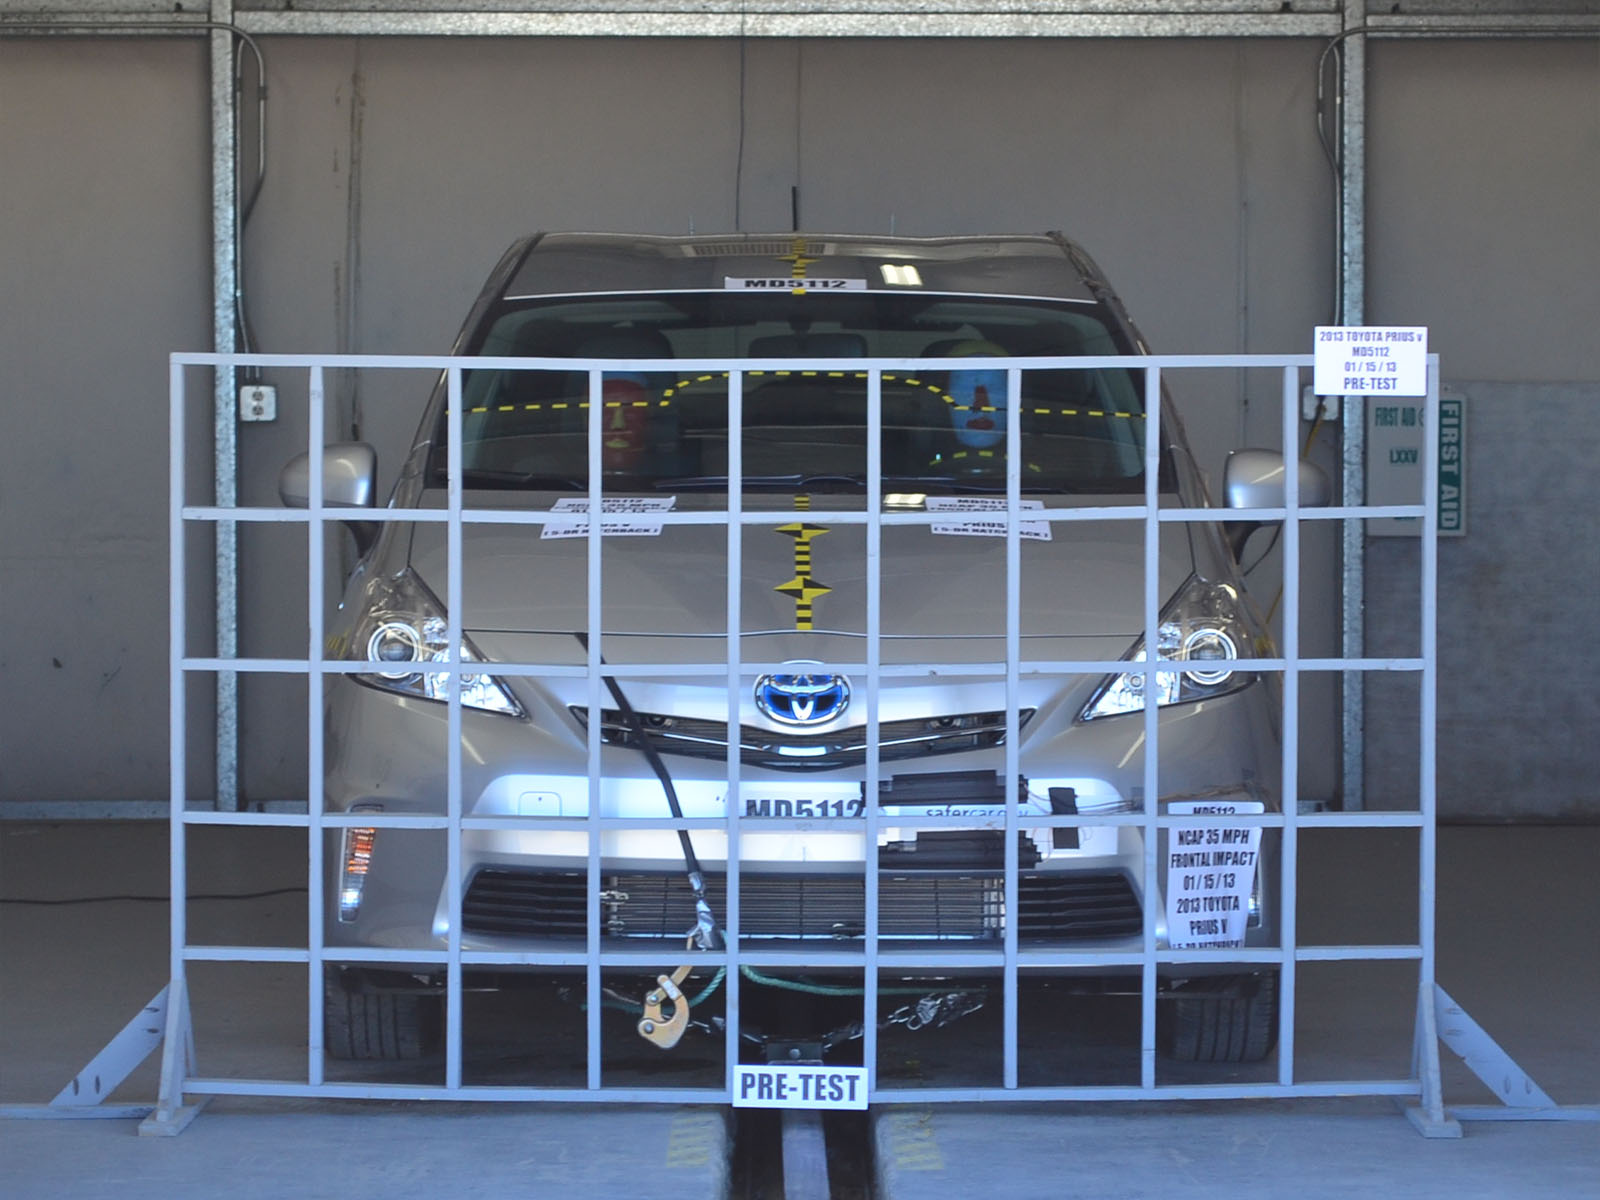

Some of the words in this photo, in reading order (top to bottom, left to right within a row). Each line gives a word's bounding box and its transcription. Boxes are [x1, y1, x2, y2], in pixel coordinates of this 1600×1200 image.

[744, 280, 848, 288] MD5112
[1320, 331, 1344, 342] 2013
[1346, 331, 1383, 342] TOYOTA
[1385, 332, 1415, 342] PRIUS
[1352, 346, 1390, 357] MD5112
[1344, 377, 1398, 390] PRE-TEST
[1441, 402, 1459, 475] FIRST
[1441, 484, 1459, 528] AID
[1178, 830, 1204, 846] NCAP
[1206, 829, 1220, 844] 35
[1222, 829, 1250, 844] MPH
[1170, 852, 1211, 868] FRONTAL
[1212, 852, 1256, 867] IMPACT
[1176, 898, 1200, 914] 2013
[1202, 896, 1240, 913] TOYOTA
[1189, 920, 1220, 936] PRIUS
[740, 1072, 860, 1102] PRE-TEST
